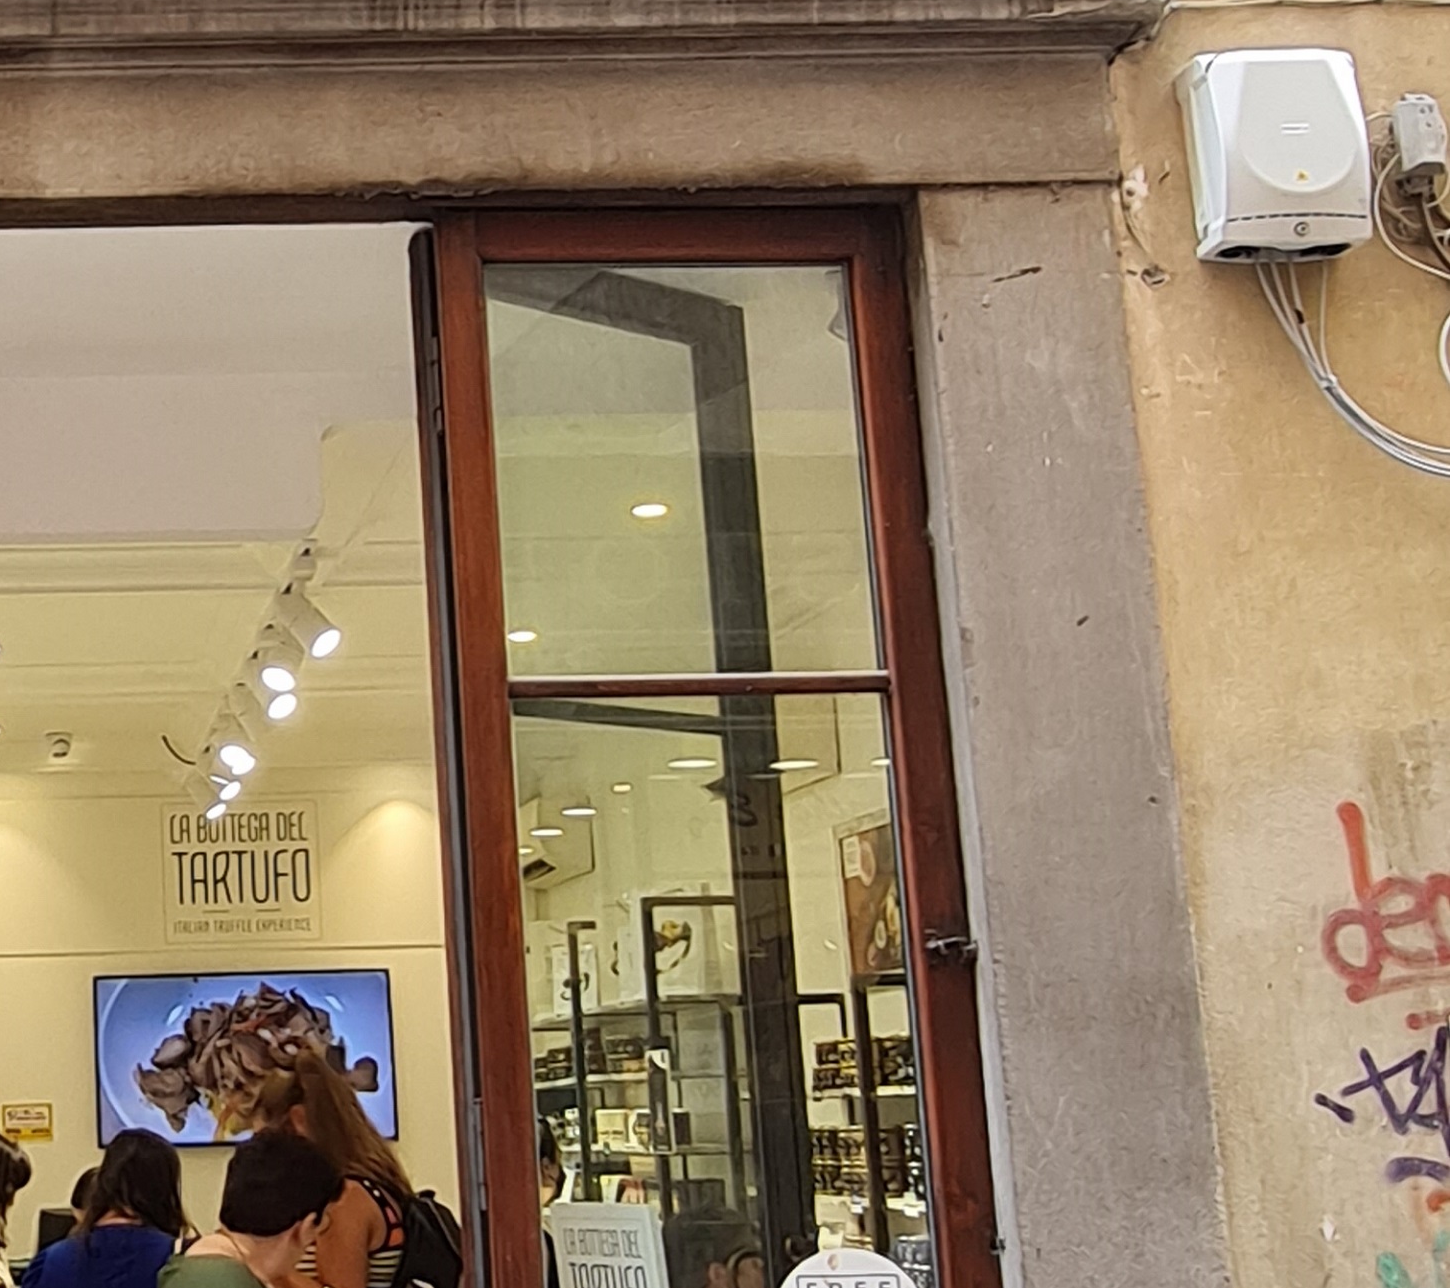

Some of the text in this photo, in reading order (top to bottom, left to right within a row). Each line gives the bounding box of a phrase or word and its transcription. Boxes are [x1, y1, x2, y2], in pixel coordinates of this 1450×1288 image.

[170, 810, 309, 845] LA BOTTEGA DEL
[171, 847, 311, 906] TARTUFO
